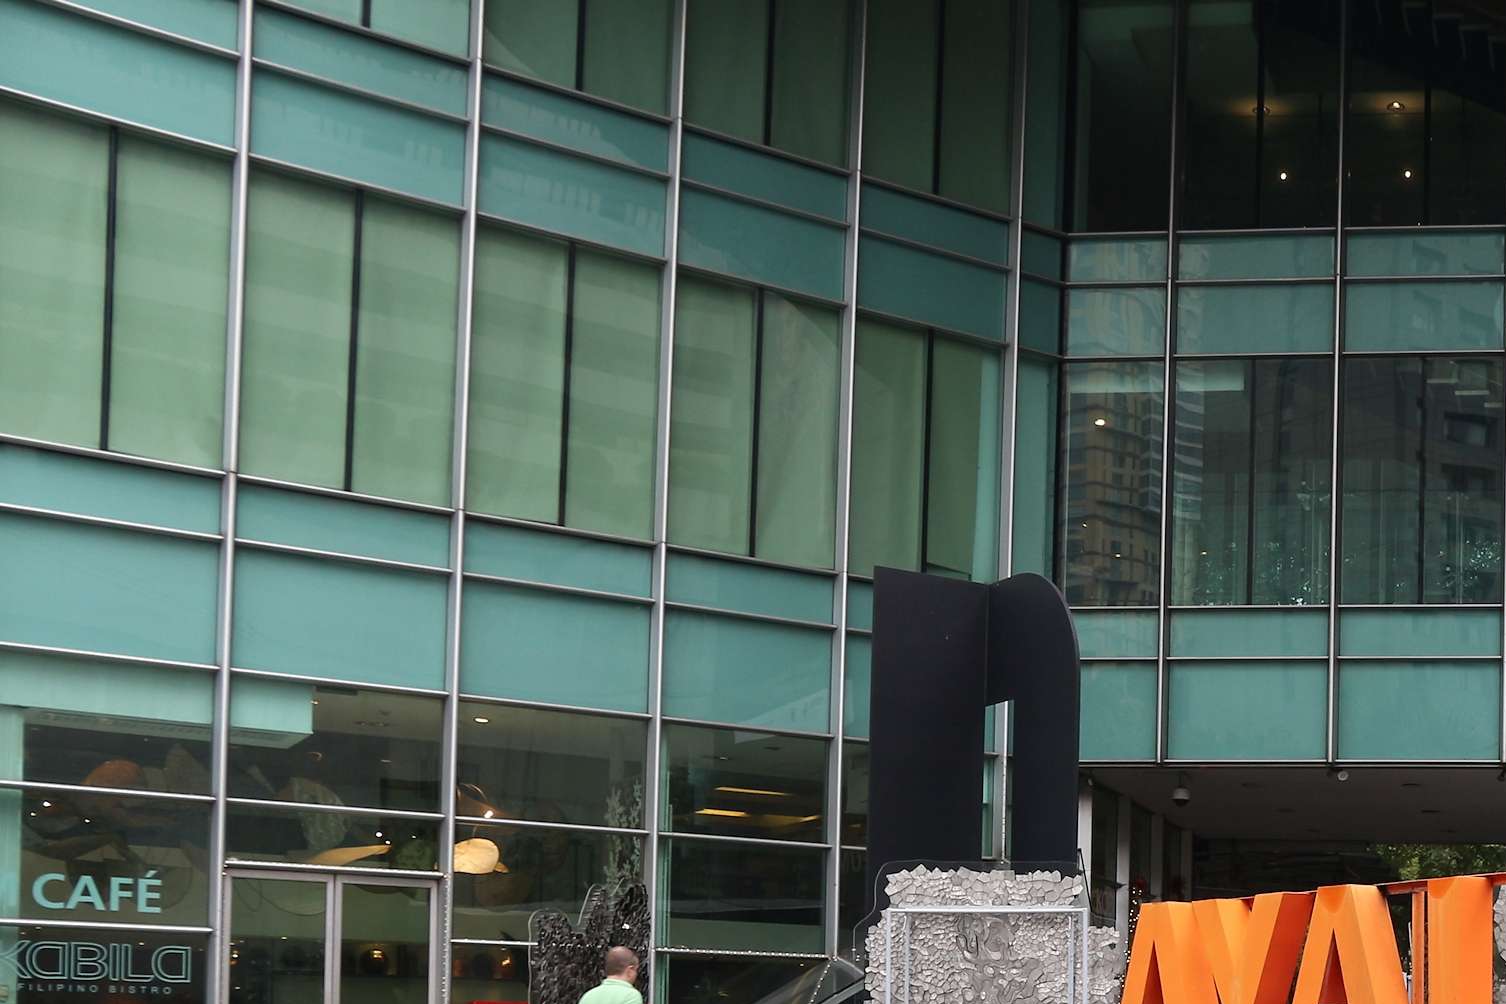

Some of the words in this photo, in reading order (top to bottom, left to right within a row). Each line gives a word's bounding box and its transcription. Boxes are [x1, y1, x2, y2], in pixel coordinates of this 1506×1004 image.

[32, 870, 162, 914] CAFÉ
[17, 983, 99, 993] FILIPINO
[109, 984, 172, 995] BISTRO
